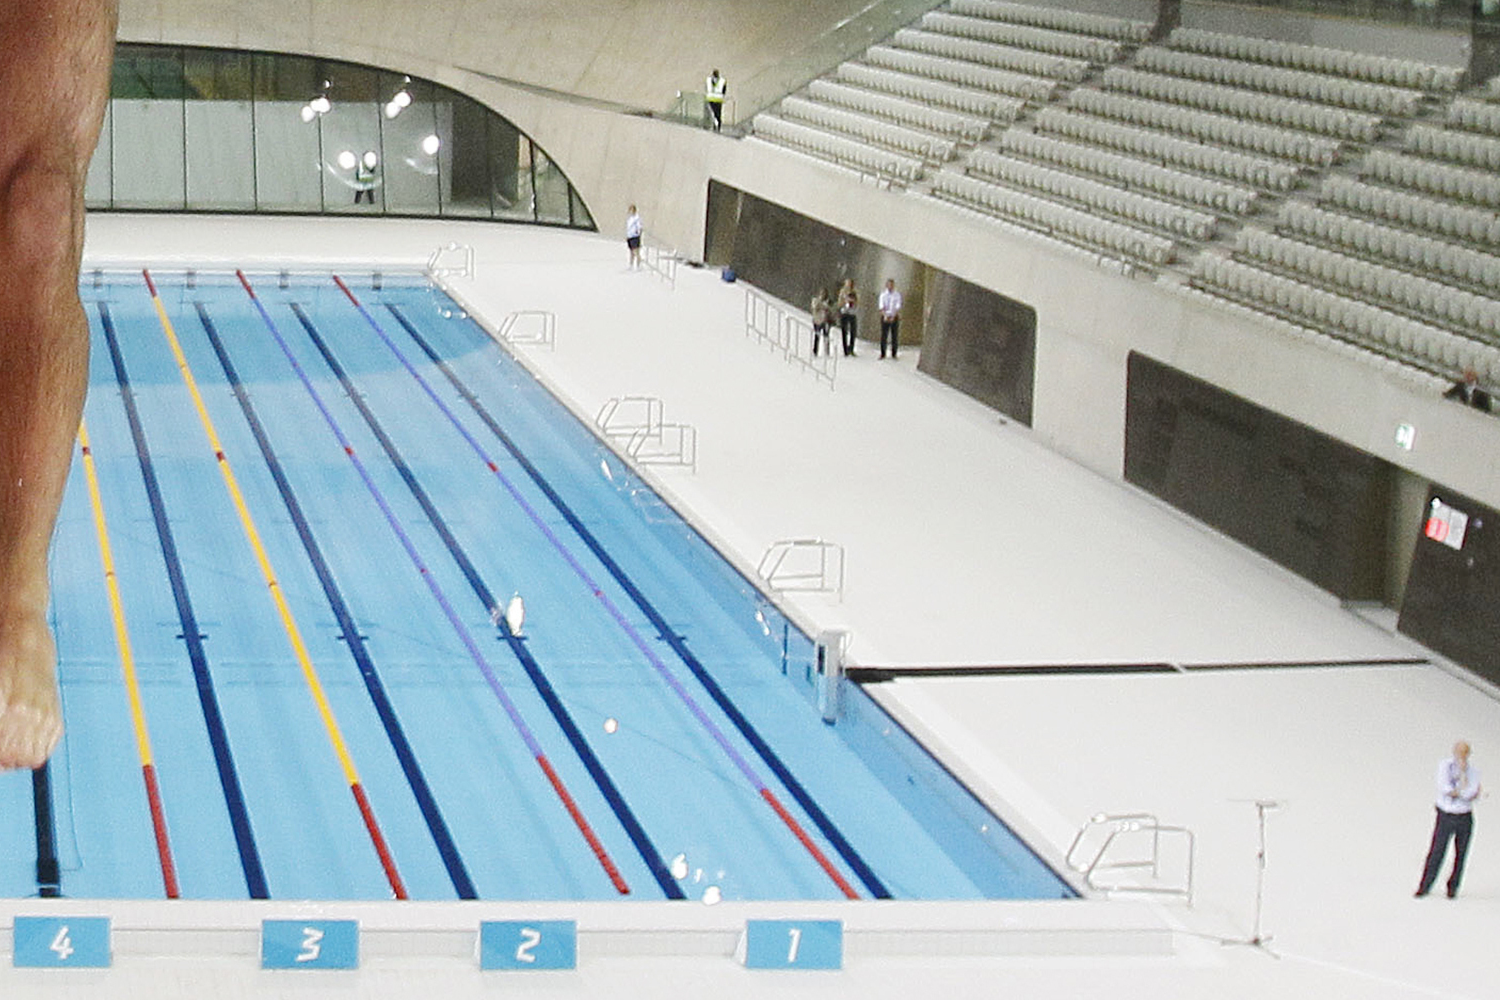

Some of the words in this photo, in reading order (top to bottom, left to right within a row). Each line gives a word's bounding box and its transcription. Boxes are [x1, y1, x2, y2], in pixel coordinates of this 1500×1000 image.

[49, 925, 73, 959] 4
[296, 928, 323, 961] 3
[516, 929, 541, 962] 2
[786, 928, 801, 962] 1
